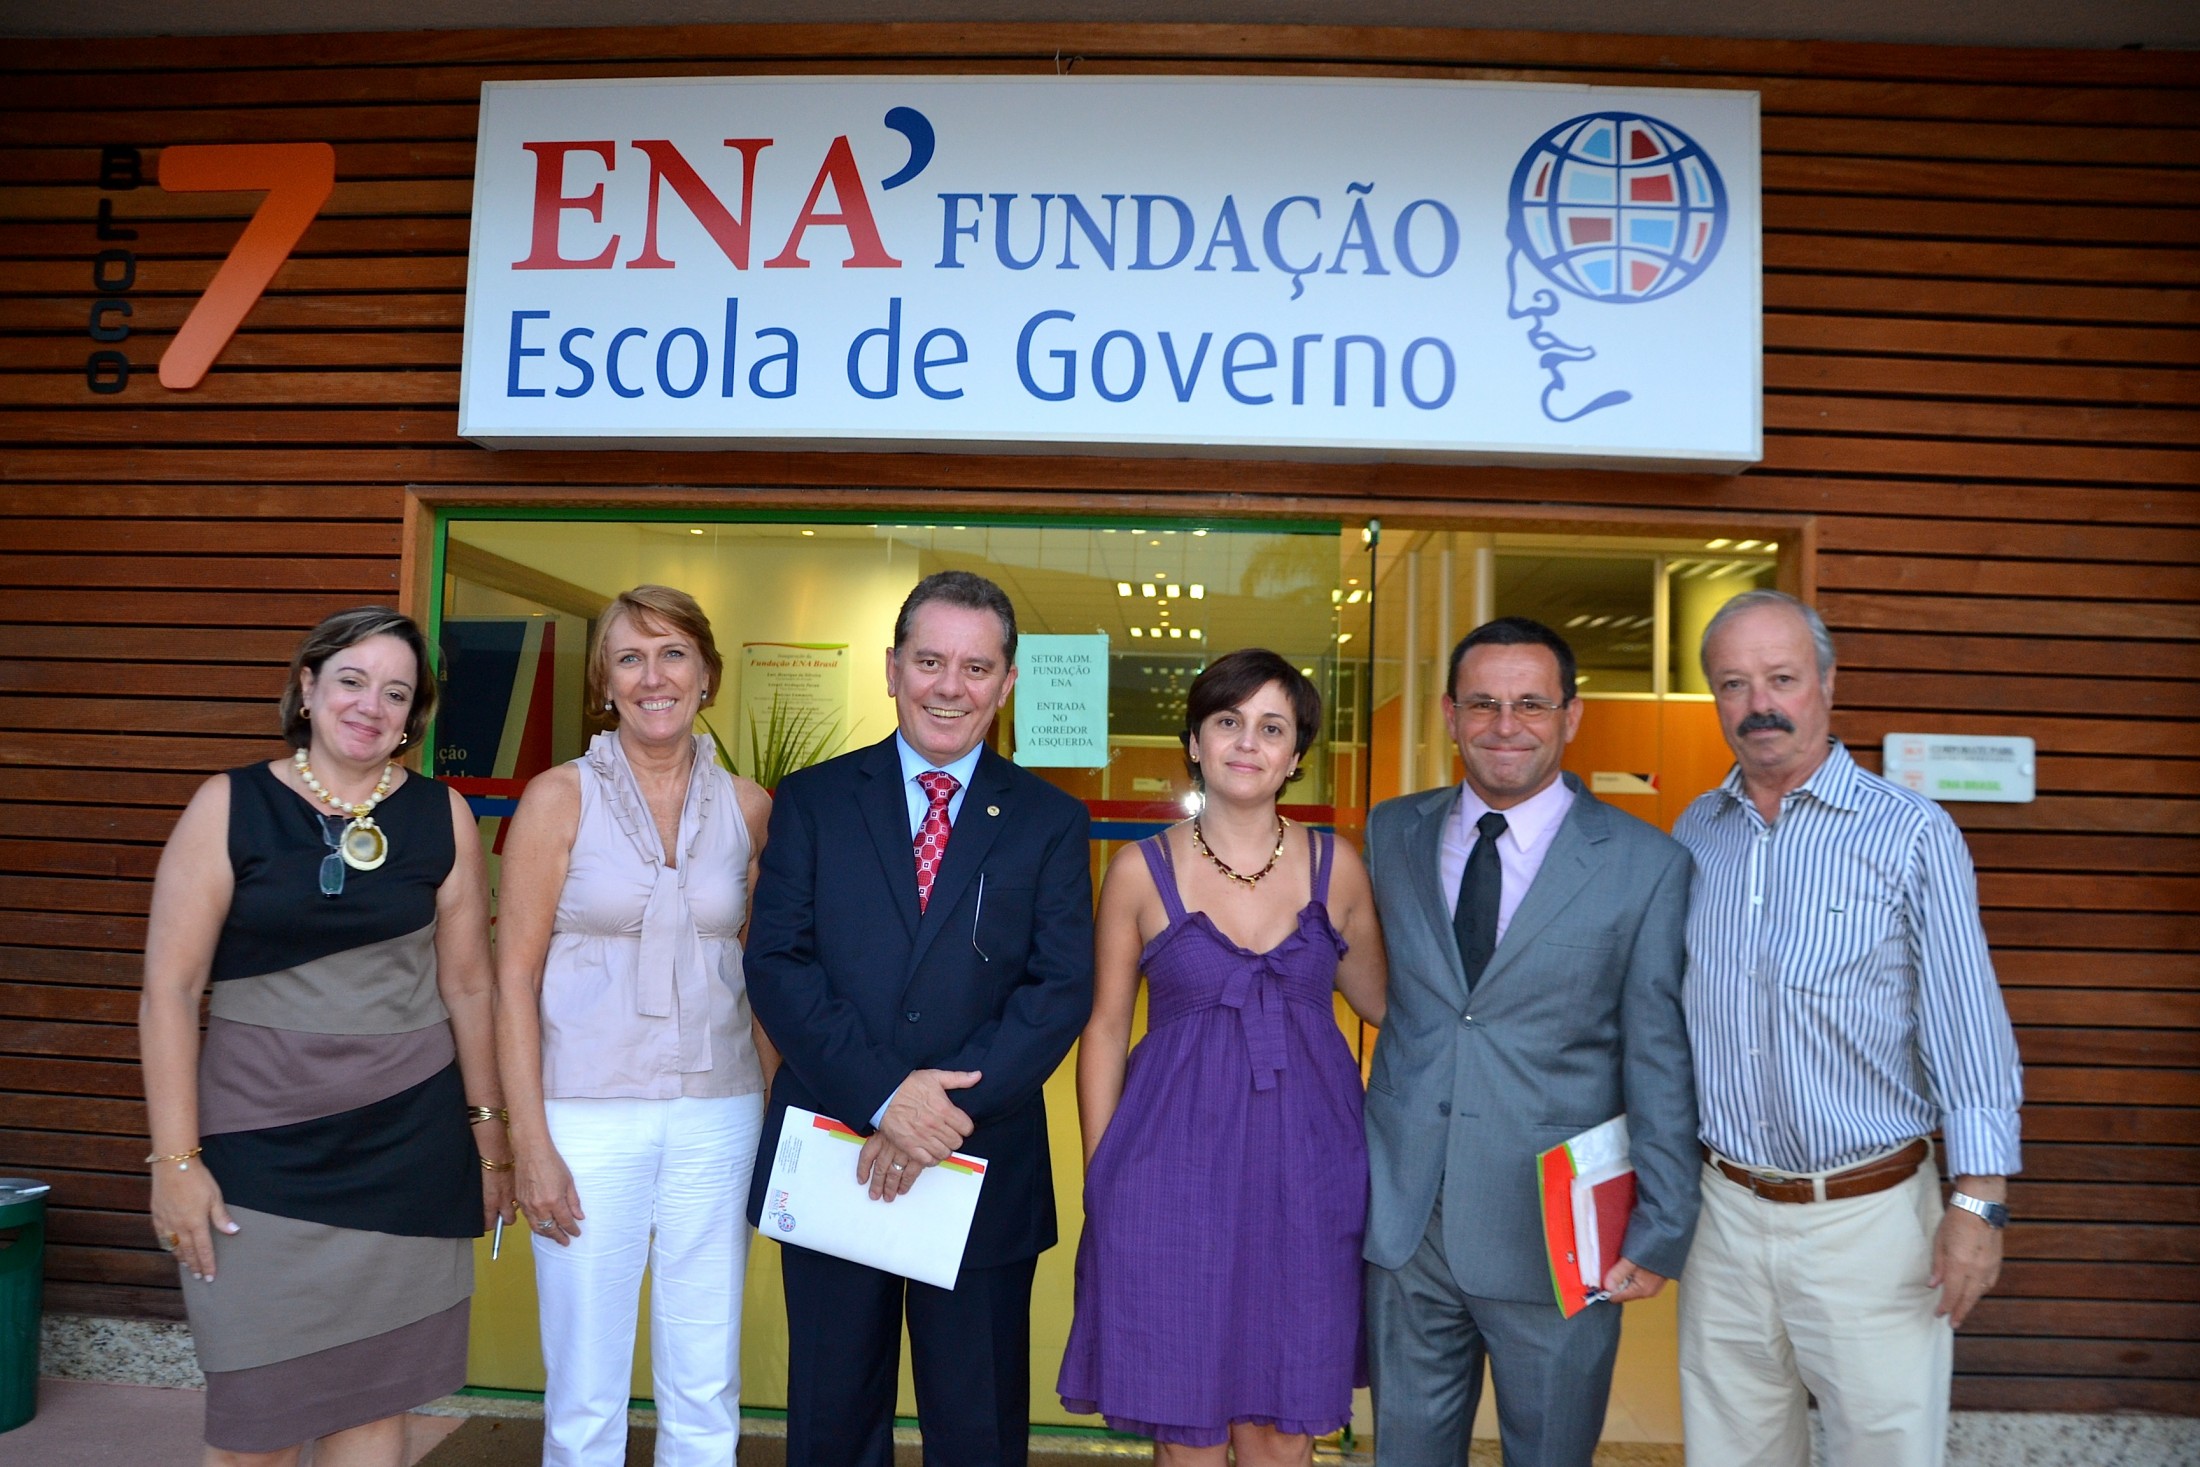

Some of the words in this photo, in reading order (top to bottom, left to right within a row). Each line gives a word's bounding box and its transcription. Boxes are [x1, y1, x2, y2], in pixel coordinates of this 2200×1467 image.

[934, 181, 1460, 301] FUNDAÇÃO
[86, 145, 142, 394] BLOCO
[158, 142, 335, 389] 7
[506, 297, 799, 399] Escola
[846, 297, 968, 400] de
[1016, 309, 1457, 410] Governo
[750, 659, 790, 668] Fundação
[792, 659, 811, 667] ENA
[813, 660, 838, 668] Brasil
[1031, 654, 1063, 663] SETOR
[1033, 665, 1090, 677] FUNDAÇÃO
[1051, 679, 1072, 688] ENA
[1037, 702, 1086, 711] ENTRADA
[1052, 714, 1068, 722] NO
[1031, 725, 1087, 735] CORREDOR
[1028, 738, 1036, 747] A
[1038, 737, 1093, 748] ESQUERDA
